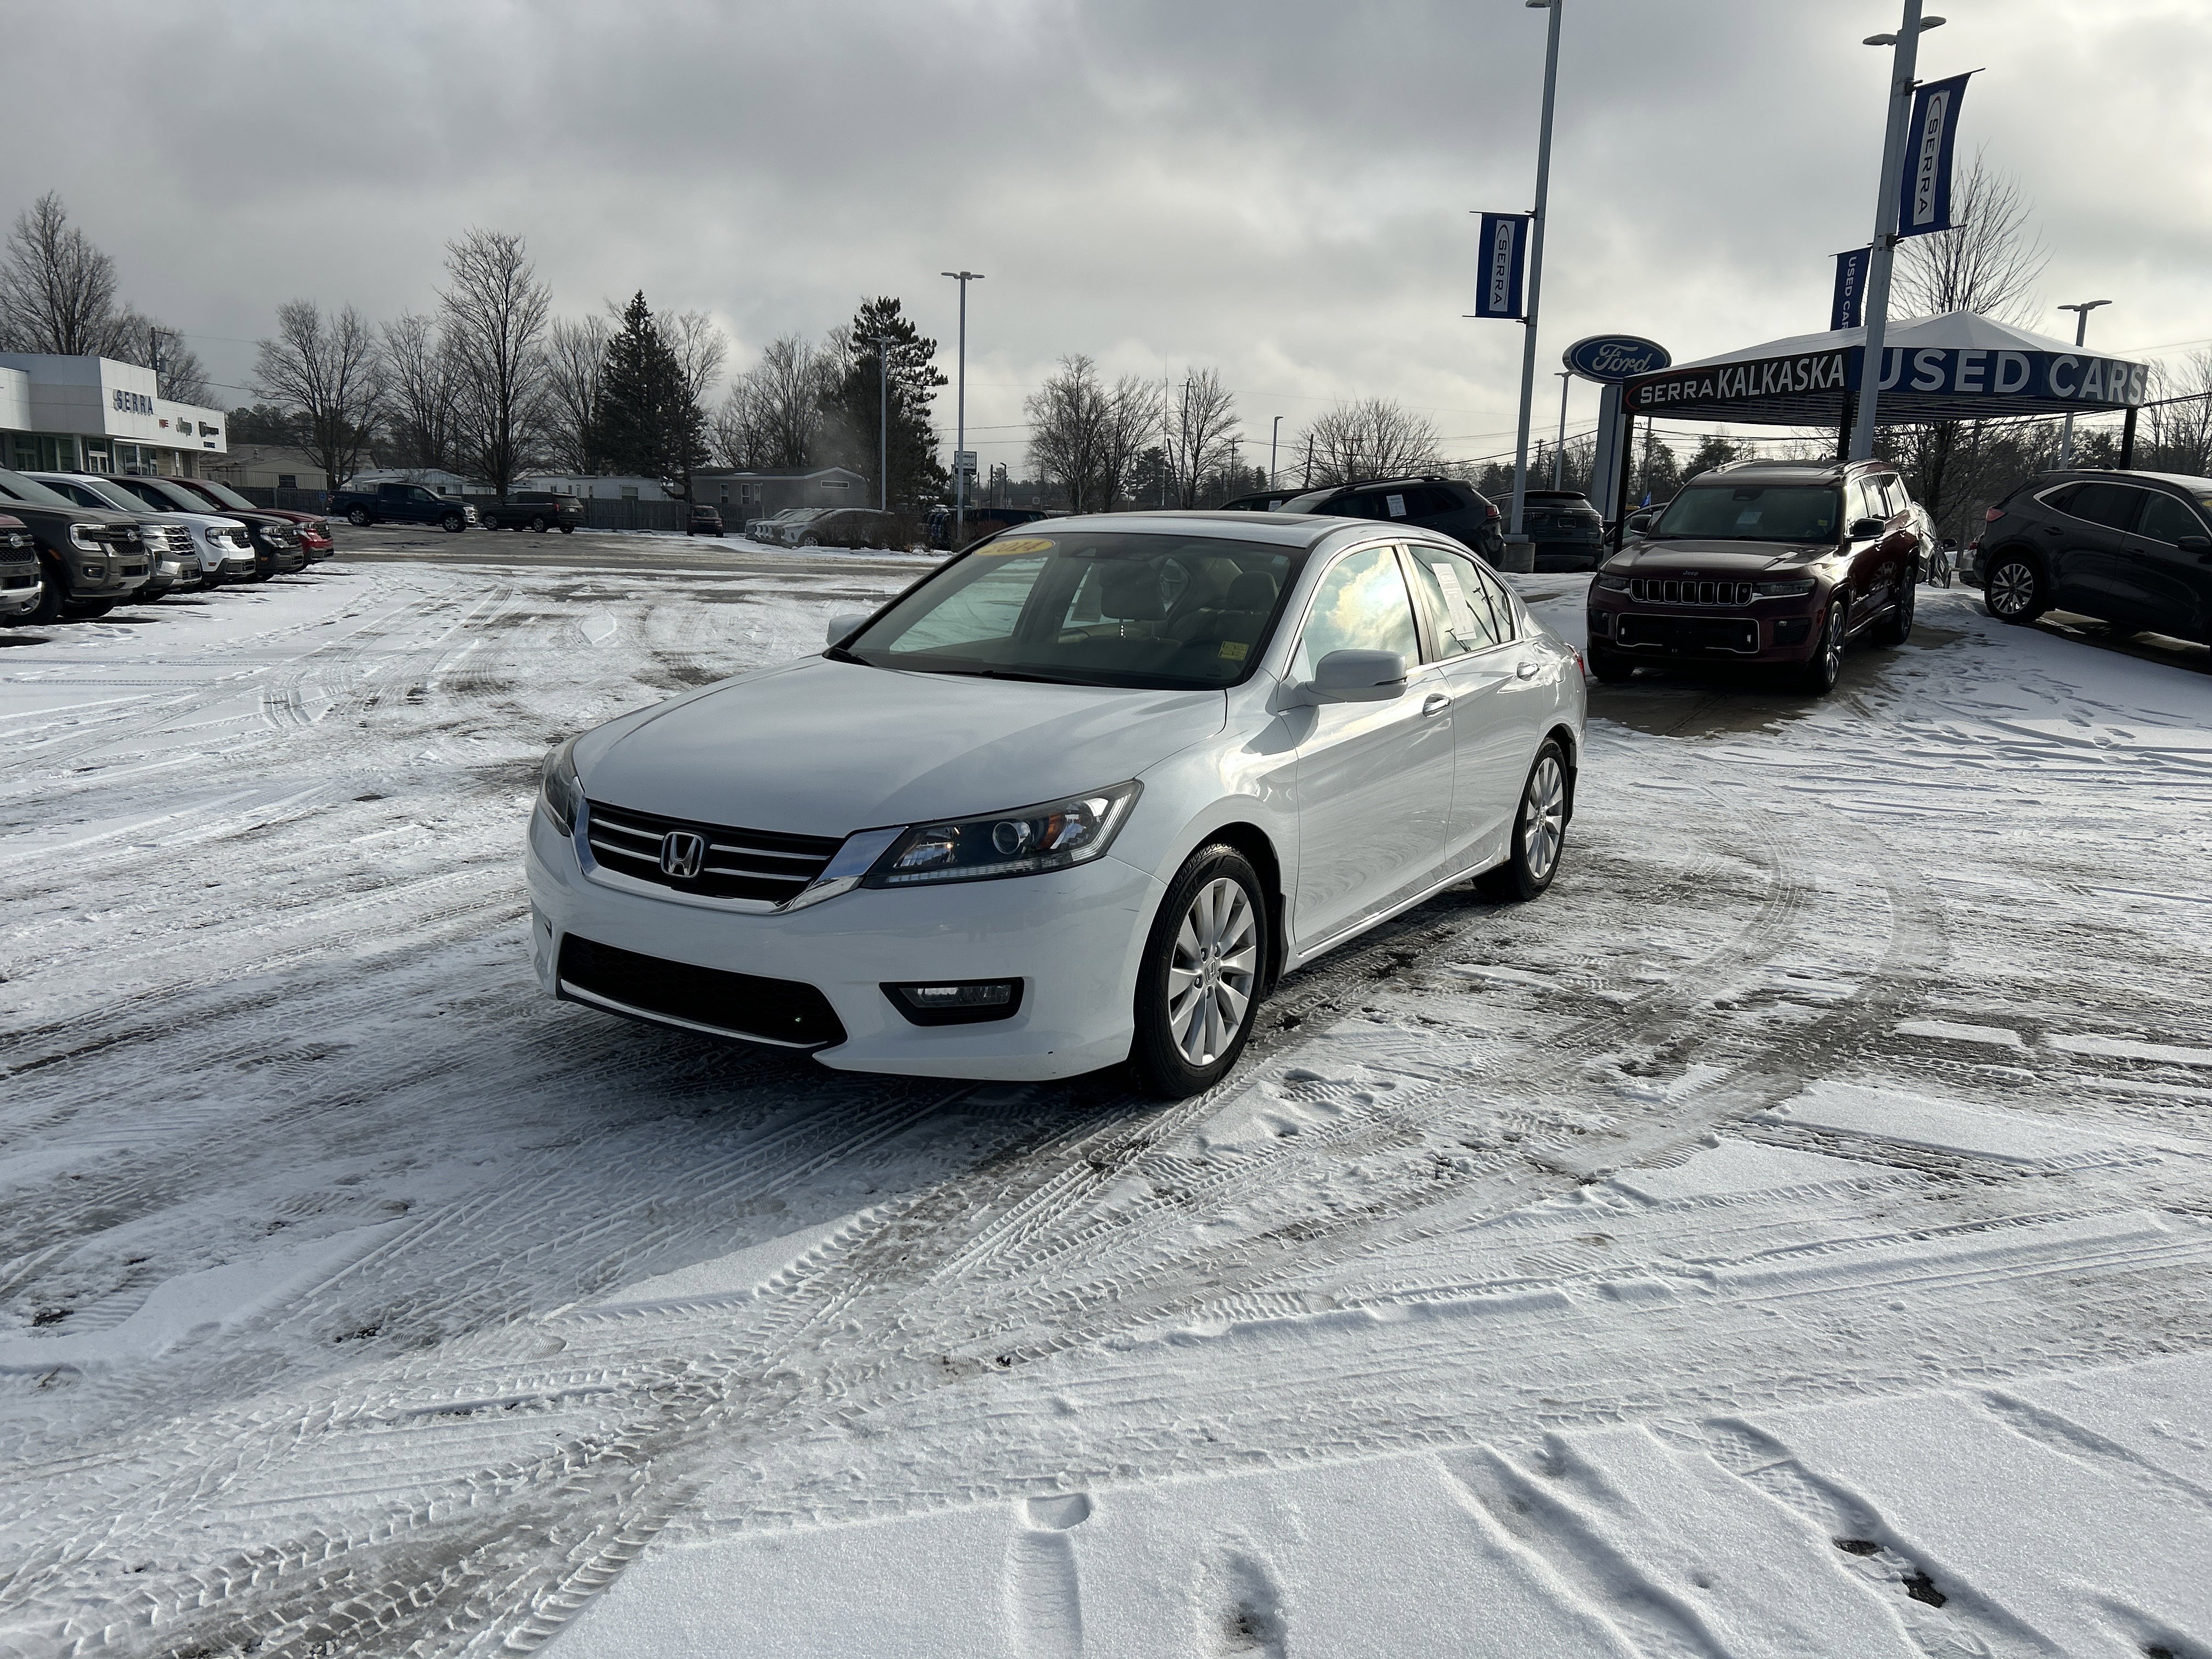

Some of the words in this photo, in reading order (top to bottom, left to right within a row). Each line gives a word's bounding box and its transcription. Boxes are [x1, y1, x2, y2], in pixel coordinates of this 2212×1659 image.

[1918, 118, 1938, 215] SERRA
[1493, 239, 1507, 305] SERRA
[1844, 256, 1857, 297] USED
[1592, 343, 1653, 373] Ford
[1640, 379, 1713, 404] SERRA
[1717, 354, 1844, 399] KALKASKA
[2049, 354, 2145, 406] CARS
[115, 390, 154, 415] SERRA
